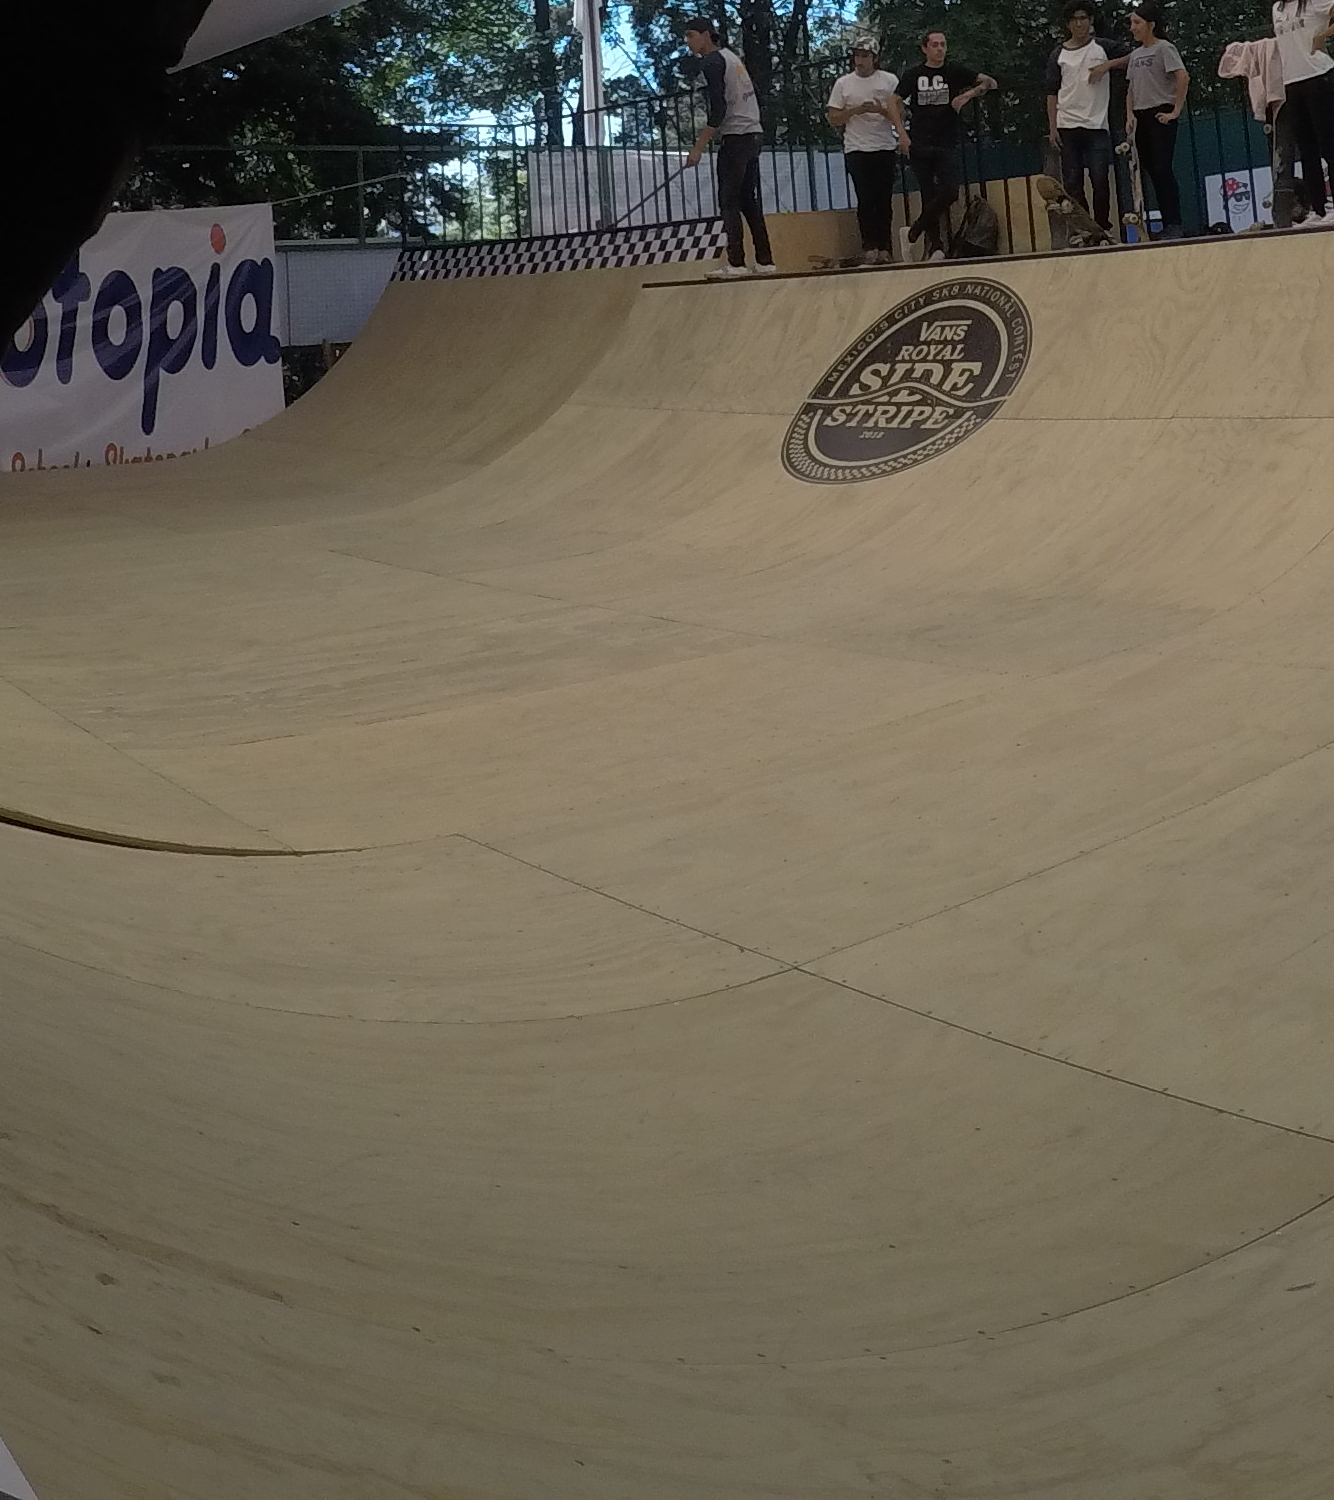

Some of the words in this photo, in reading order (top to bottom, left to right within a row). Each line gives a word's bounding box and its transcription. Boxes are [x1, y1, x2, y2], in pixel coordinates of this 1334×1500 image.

[917, 74, 949, 91] O.C.
[827, 319, 890, 383] MEXICO'S
[894, 295, 927, 320] CITY
[931, 284, 960, 301] SK8
[963, 283, 1019, 319] NATIONAL
[1004, 315, 1026, 381] CONTEST
[918, 319, 973, 342] VANS
[895, 343, 966, 362] ROYAL
[848, 362, 983, 402] SIDE
[822, 404, 955, 430] STRIPE
